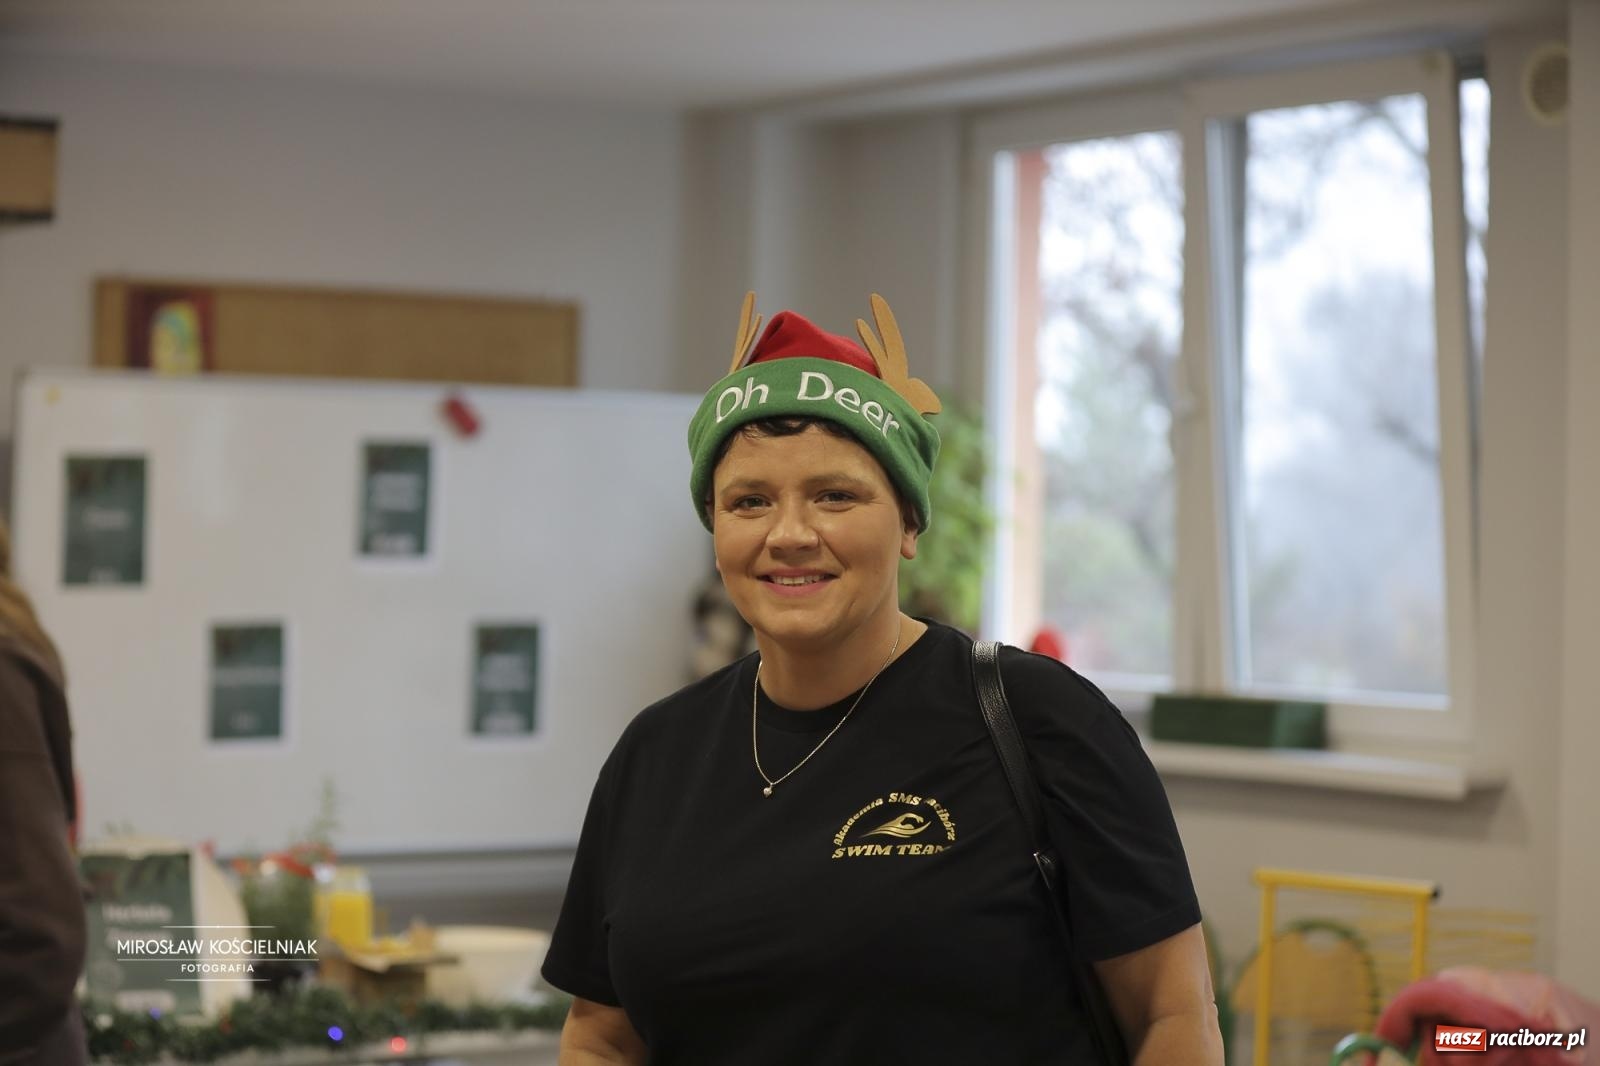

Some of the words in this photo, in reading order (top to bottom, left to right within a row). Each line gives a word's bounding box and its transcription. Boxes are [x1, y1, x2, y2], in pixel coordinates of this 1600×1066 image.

[716, 377, 769, 423] Oh
[797, 371, 900, 437] Deer
[833, 798, 884, 846] Akademia
[888, 792, 922, 806] SMS
[922, 798, 956, 841] acibórz
[832, 844, 893, 859] SWIM
